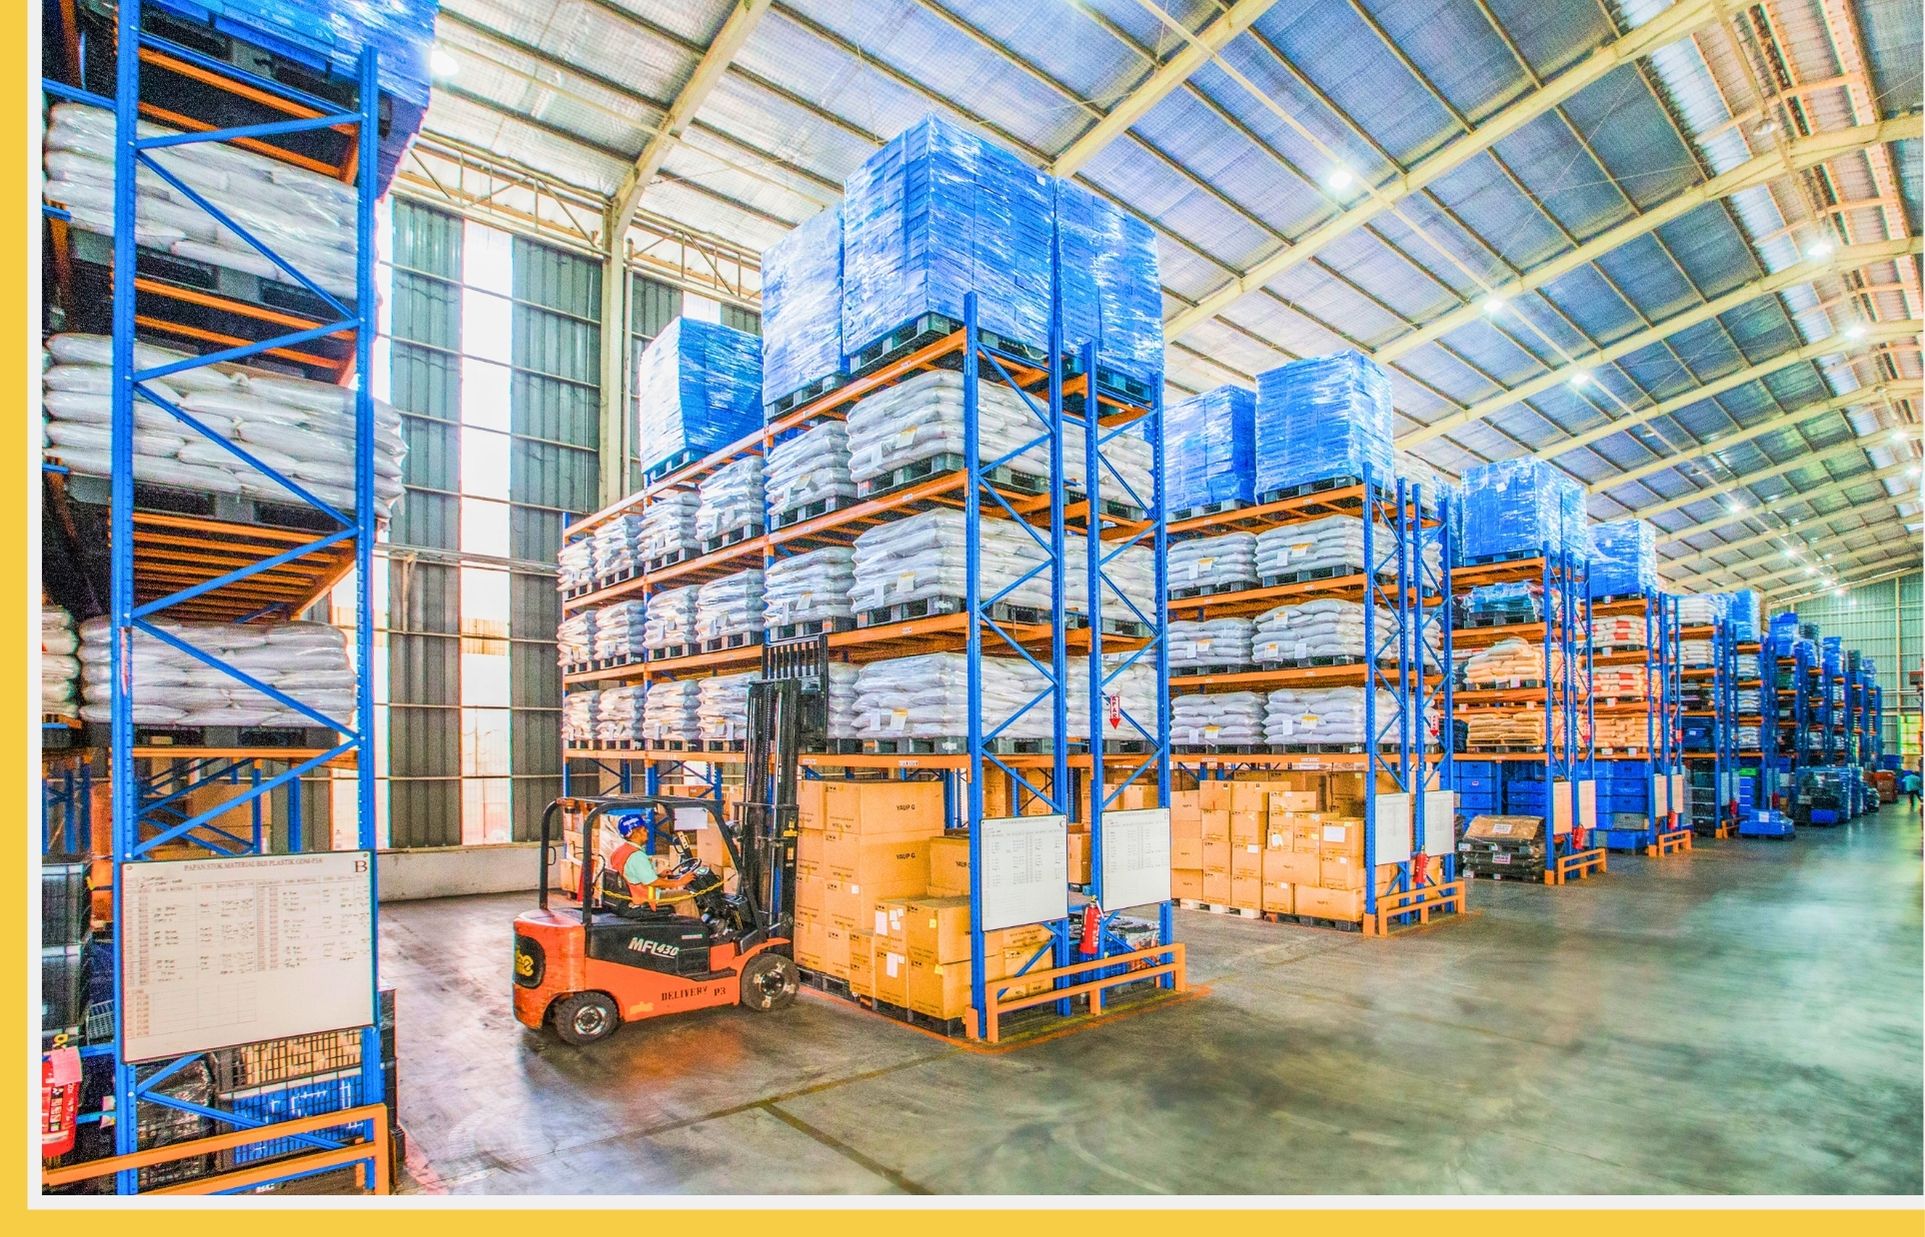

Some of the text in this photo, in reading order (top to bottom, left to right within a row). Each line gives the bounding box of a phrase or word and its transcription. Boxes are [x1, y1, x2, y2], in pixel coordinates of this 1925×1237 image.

[353, 860, 368, 873] B
[661, 985, 727, 1001] DELIVERY P3
